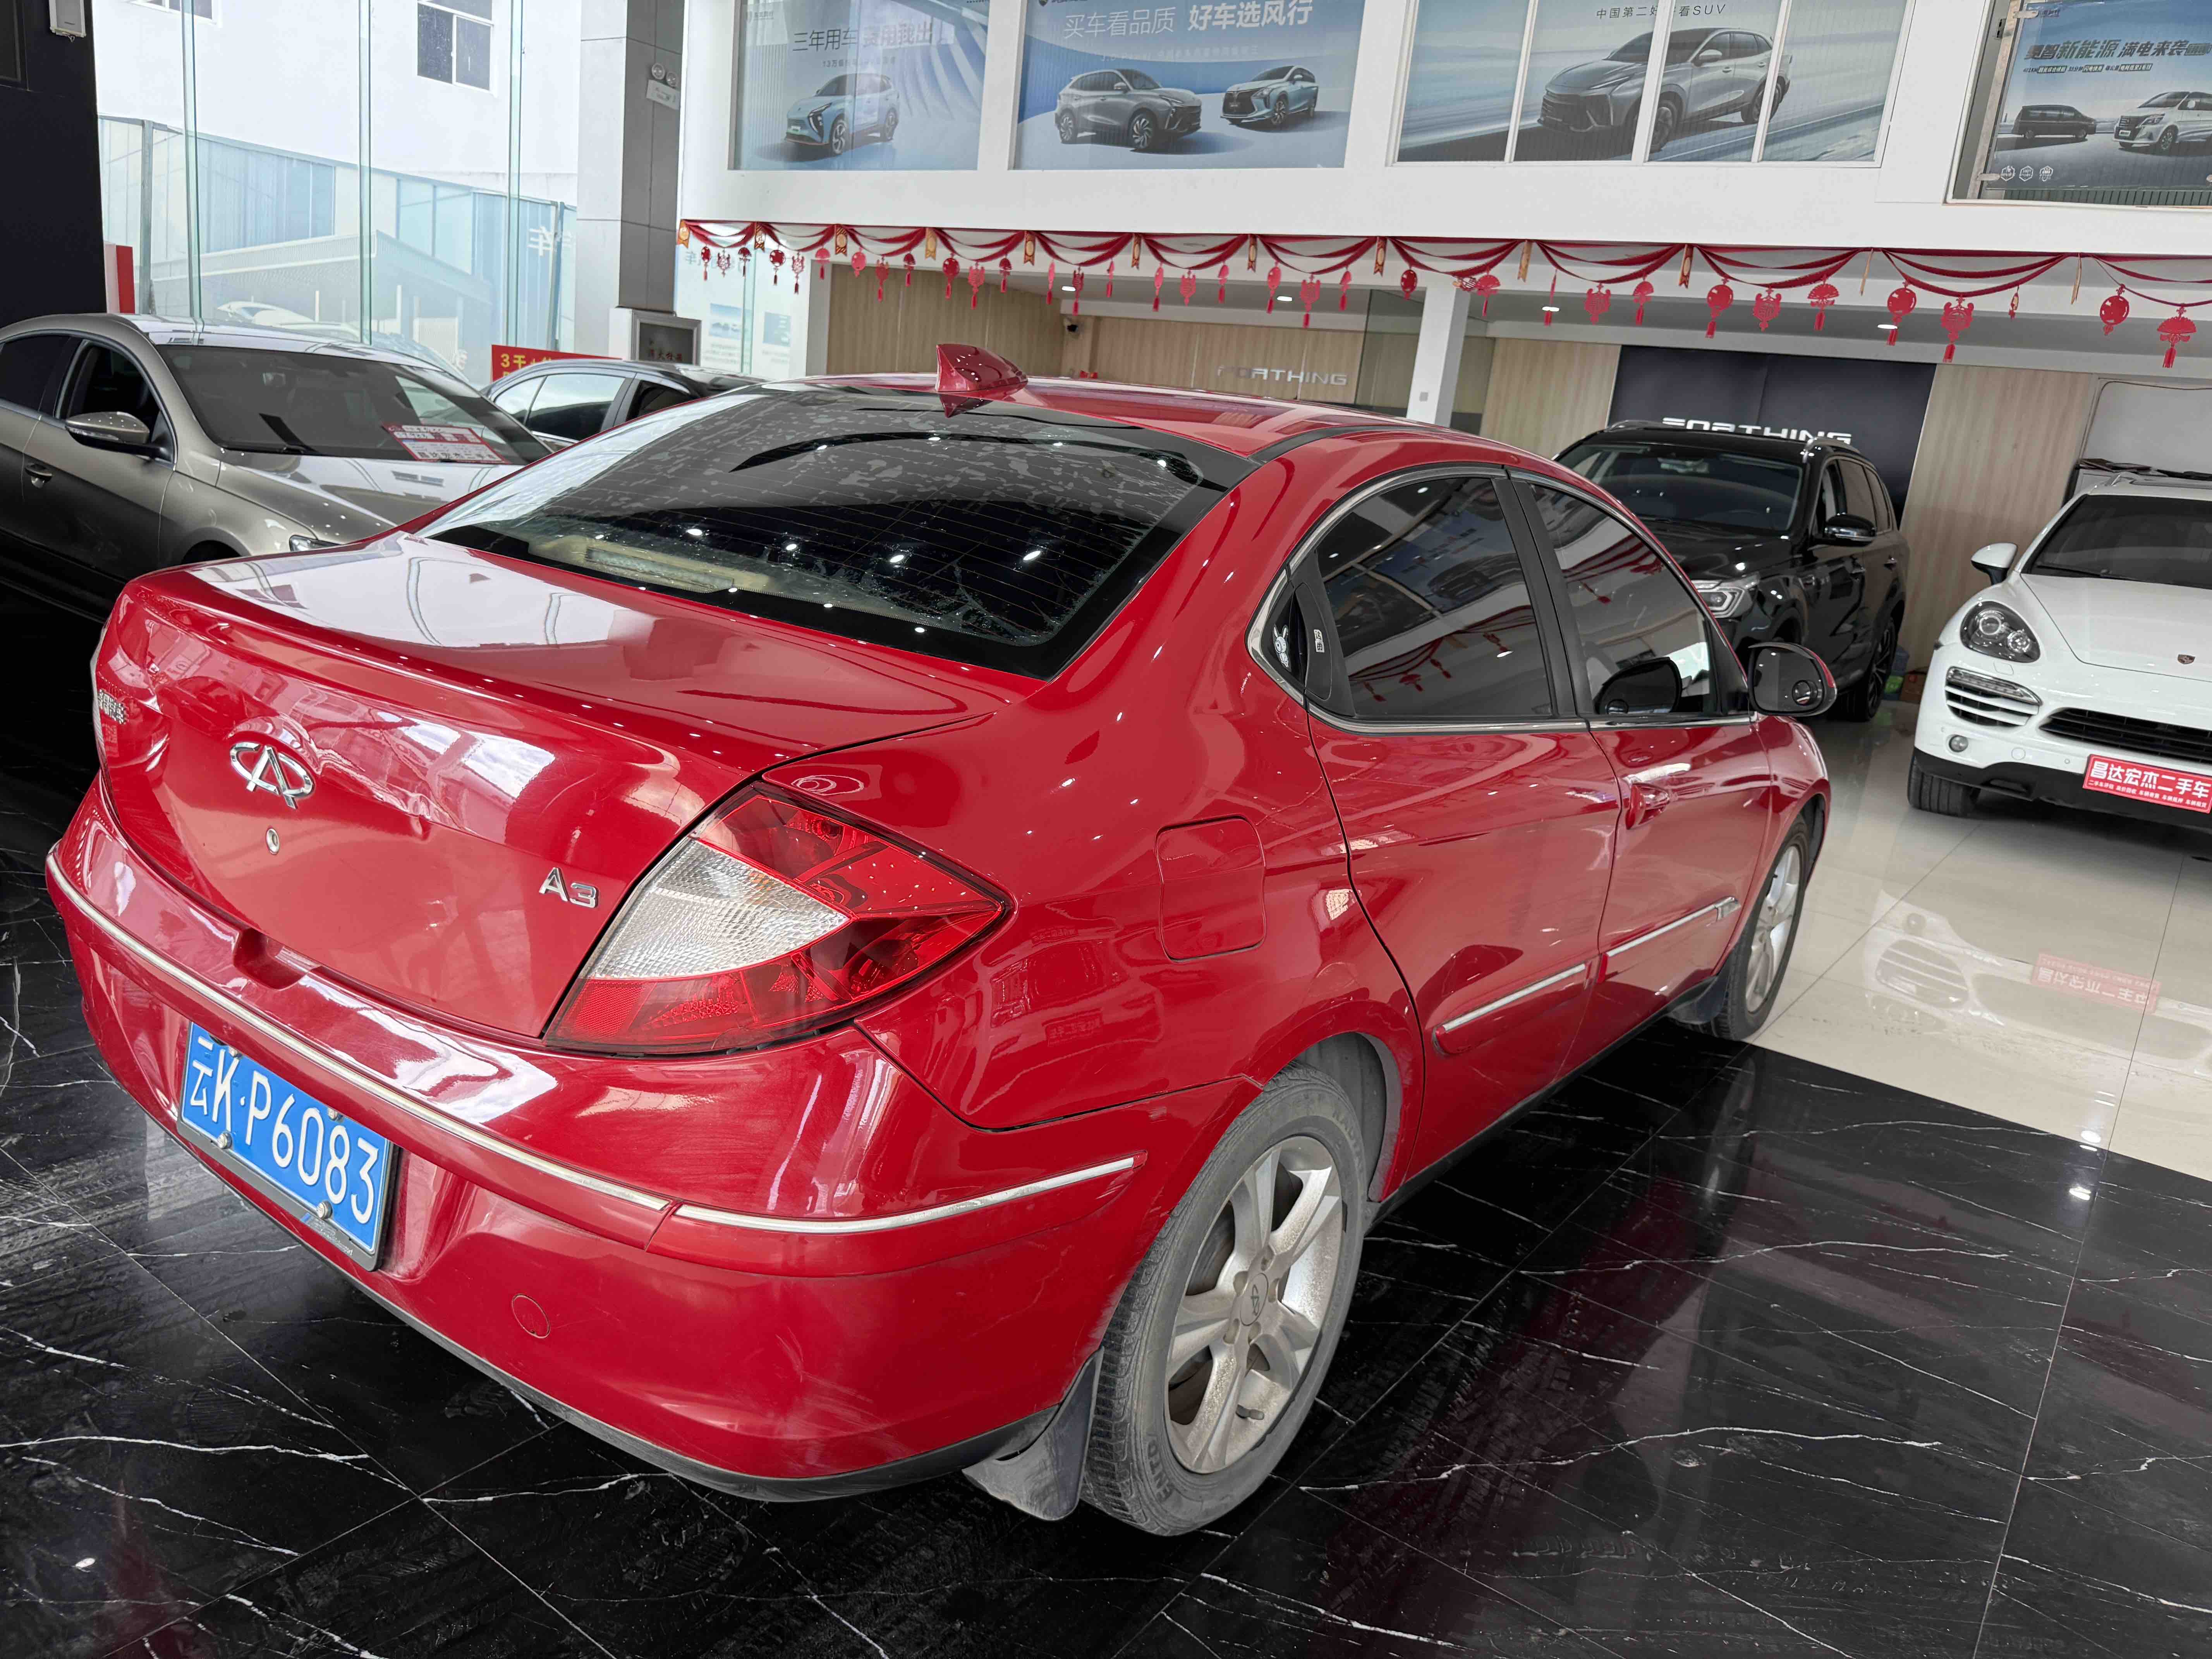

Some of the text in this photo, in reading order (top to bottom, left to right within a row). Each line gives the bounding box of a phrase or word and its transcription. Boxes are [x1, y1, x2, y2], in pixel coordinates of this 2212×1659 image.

[1064, 0, 1313, 38] 买车看品质 好车选风行
[1596, 4, 1726, 19] 中国第二好看SUV
[793, 29, 859, 51] 三年用车
[2090, 761, 2212, 799] 昌达宏杰二手车
[539, 867, 599, 908] A3
[190, 1036, 378, 1224] 云K·P6083
